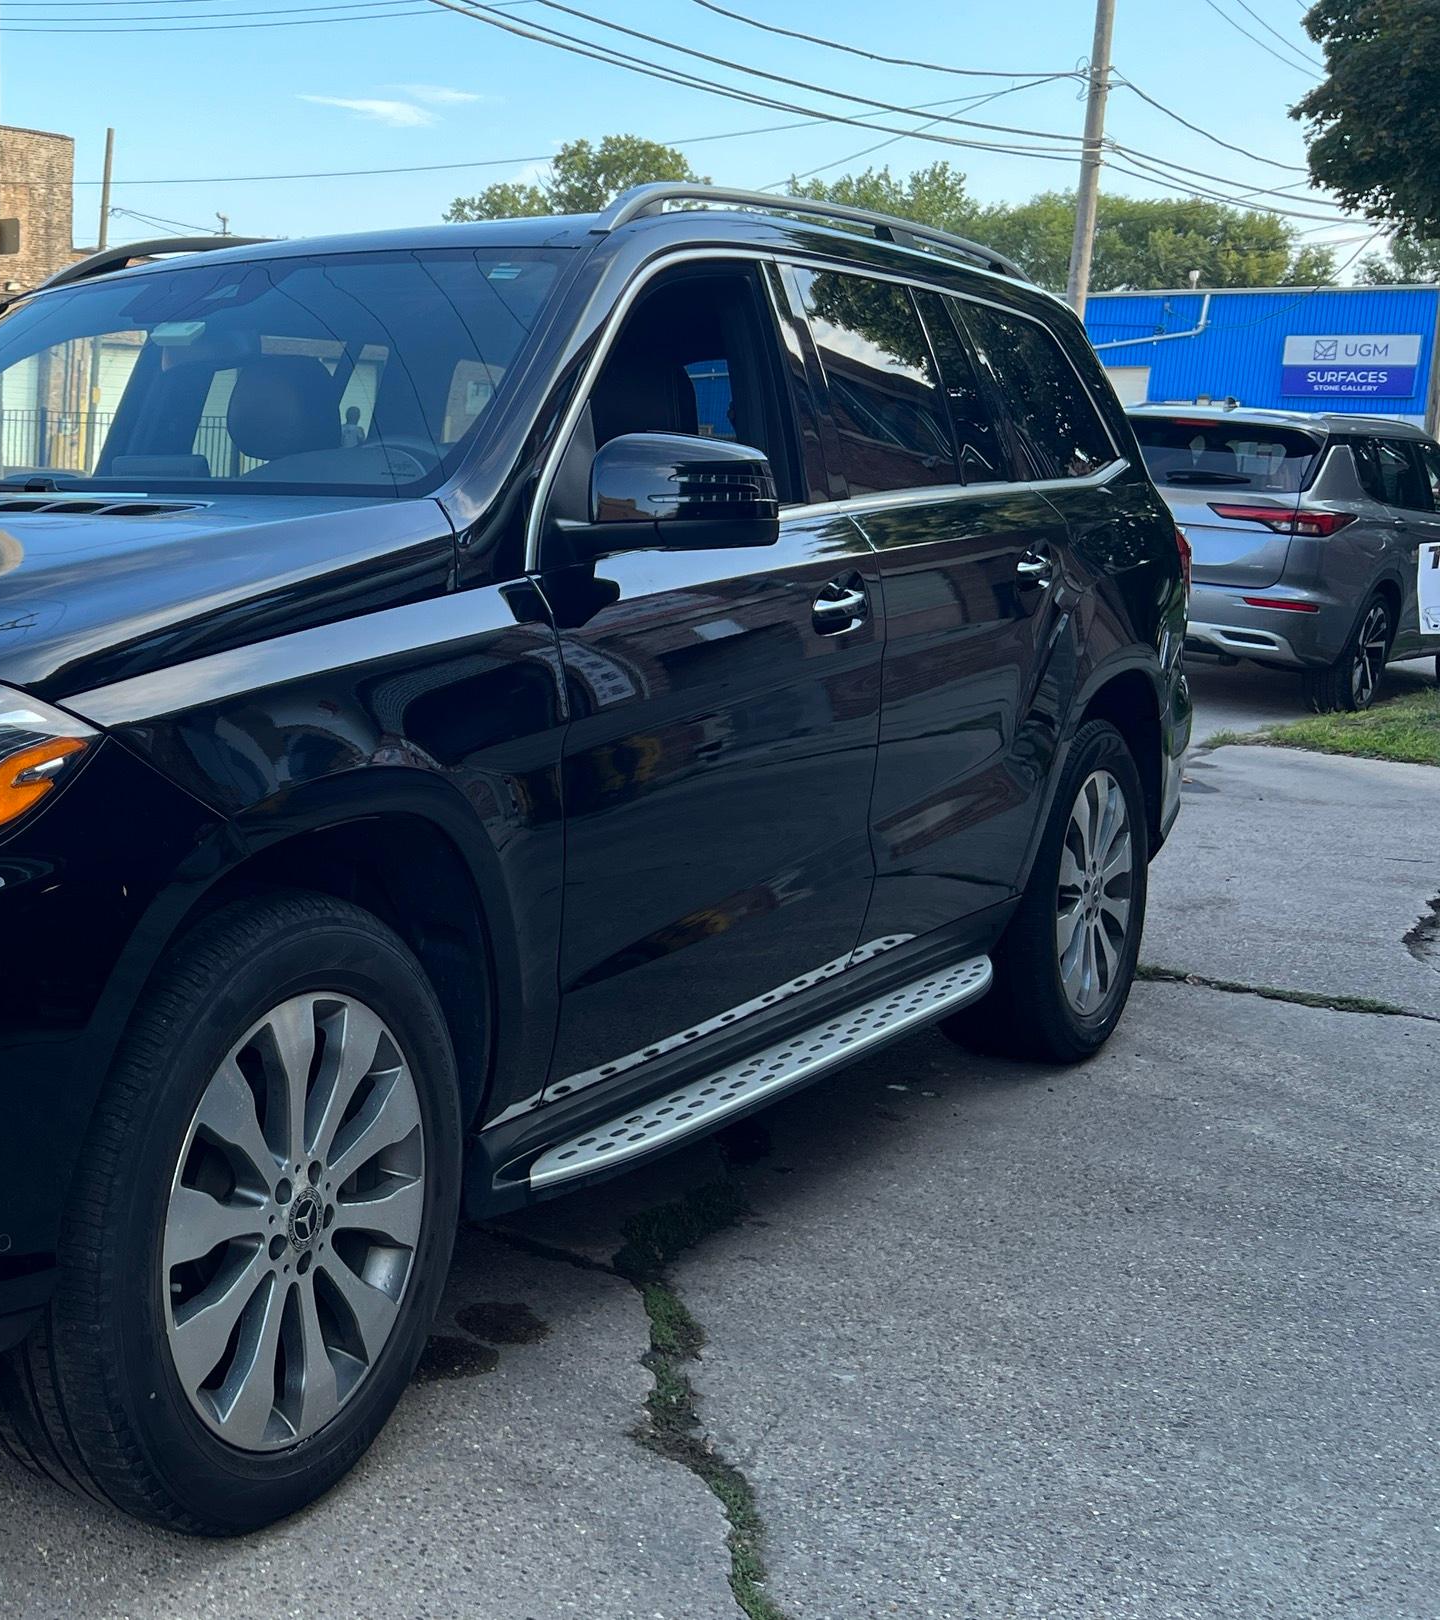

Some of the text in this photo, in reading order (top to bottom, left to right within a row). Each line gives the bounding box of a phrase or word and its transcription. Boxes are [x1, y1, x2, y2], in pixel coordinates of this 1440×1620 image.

[1344, 343, 1389, 357] UGM
[1307, 371, 1388, 383] SURFACES
[1313, 384, 1340, 392] STONE
